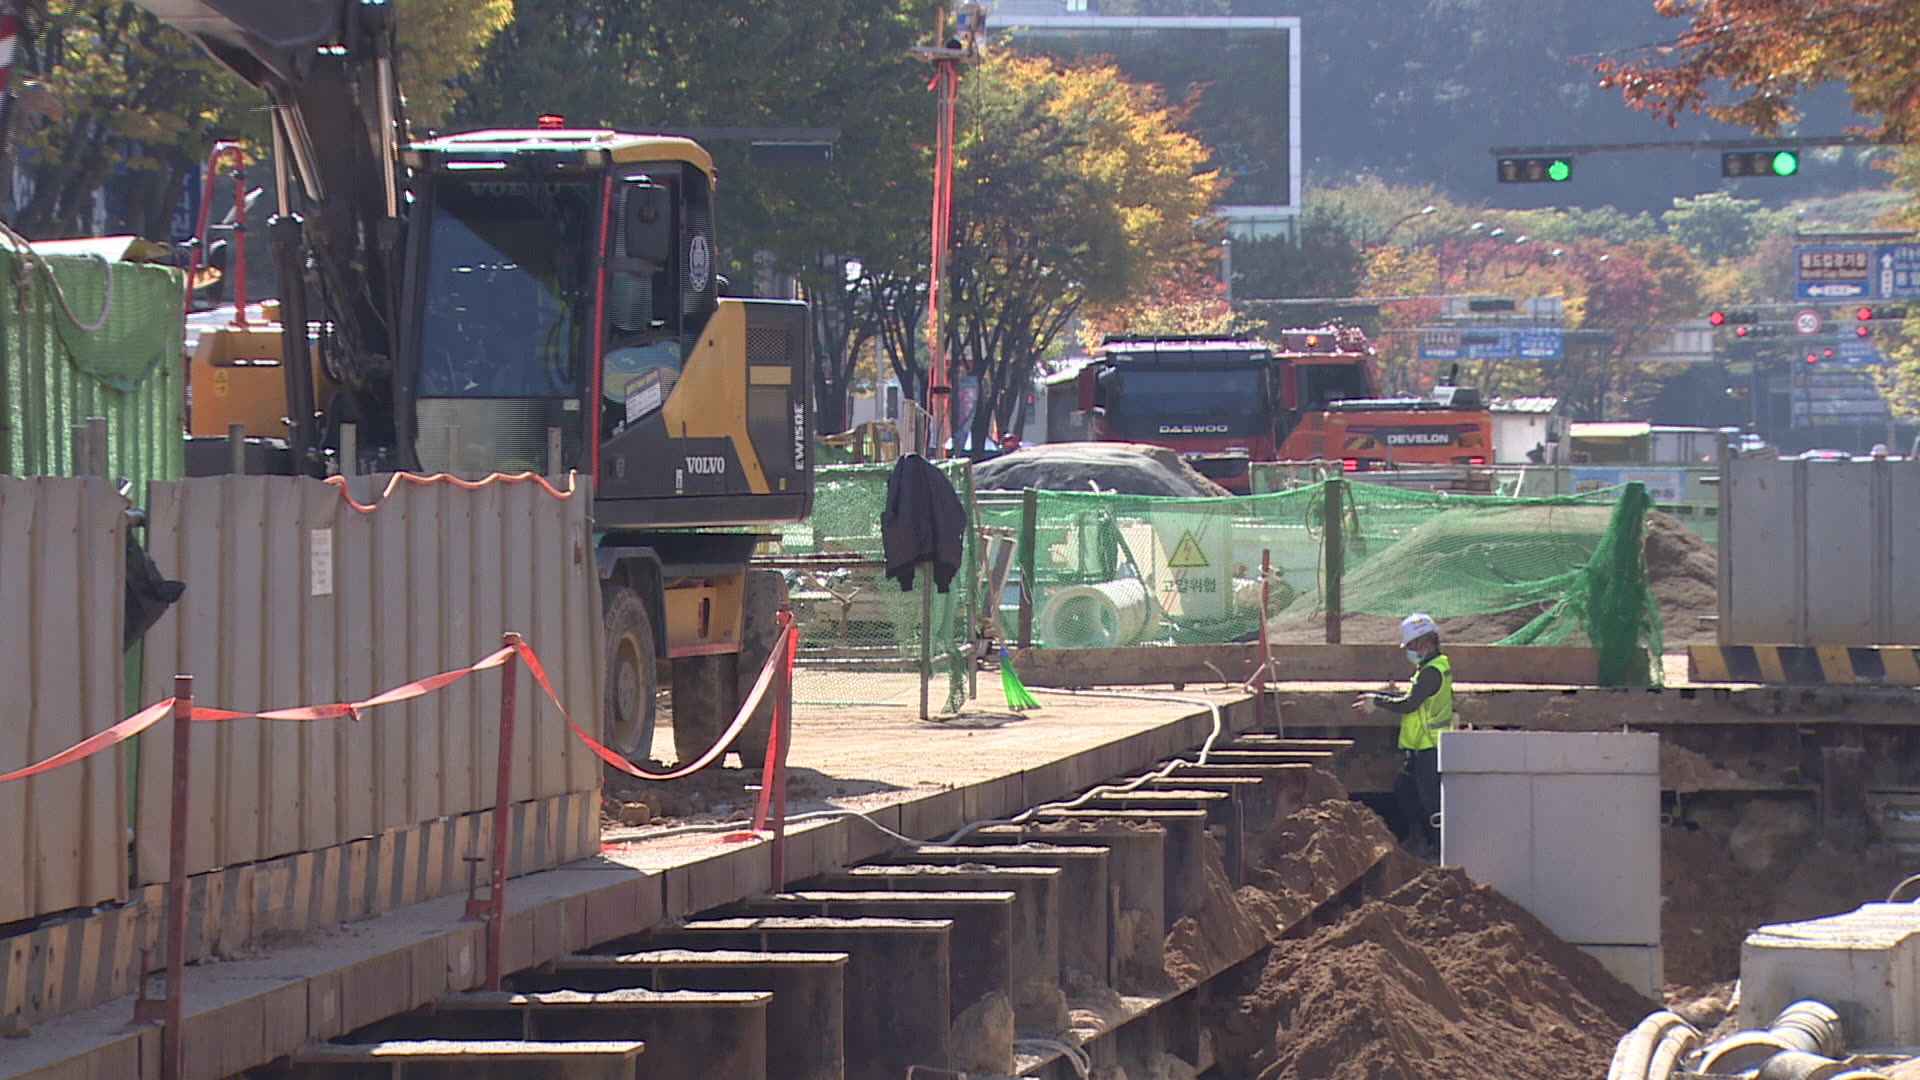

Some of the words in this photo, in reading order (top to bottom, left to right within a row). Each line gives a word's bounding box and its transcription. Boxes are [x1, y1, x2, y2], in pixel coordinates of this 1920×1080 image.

[1800, 316, 1816, 329] 50
[1159, 424, 1229, 433] DAEWOO
[1387, 434, 1449, 445] DEVELON
[685, 456, 725, 474] VOLVO
[1161, 577, 1216, 593] 고압위험
